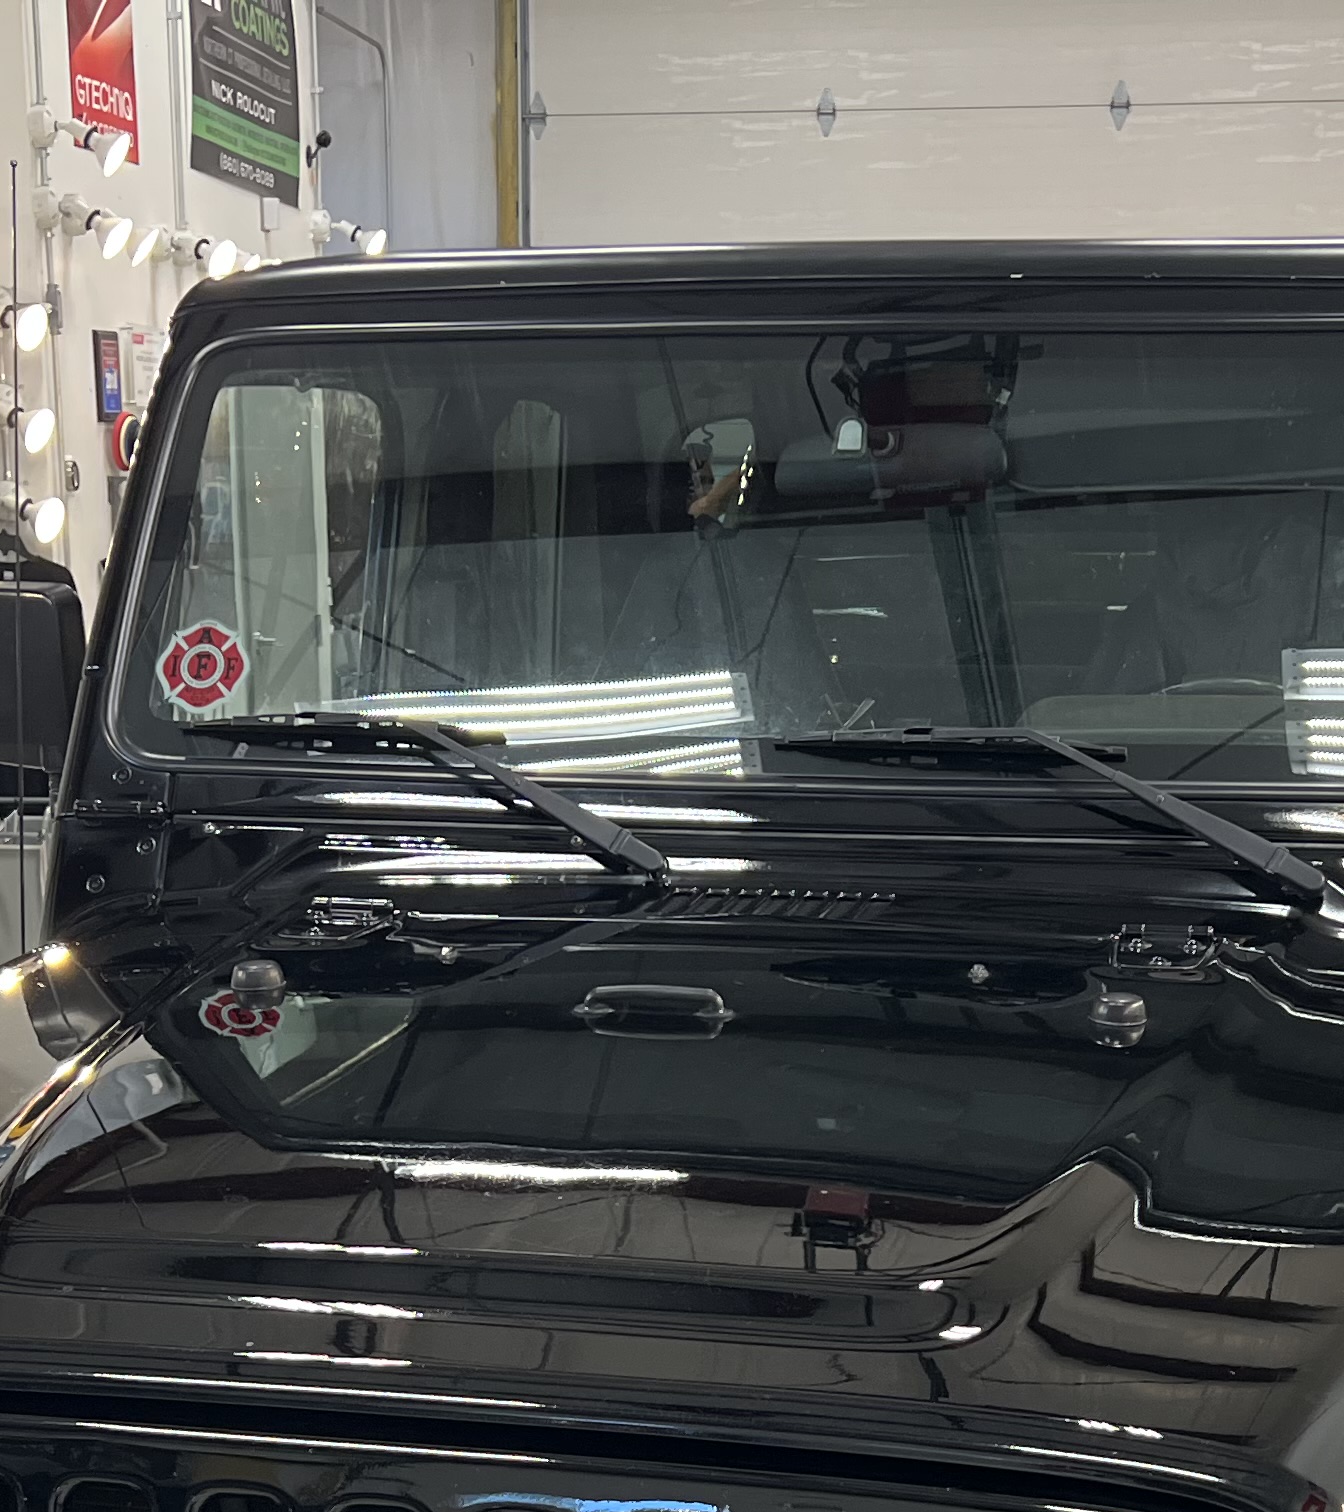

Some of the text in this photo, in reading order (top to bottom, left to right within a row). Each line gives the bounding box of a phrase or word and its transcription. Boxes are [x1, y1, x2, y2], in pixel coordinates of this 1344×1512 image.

[231, 0, 290, 56] COATINGS
[75, 74, 134, 121] GTECHNIQ
[211, 79, 234, 106] NICK
